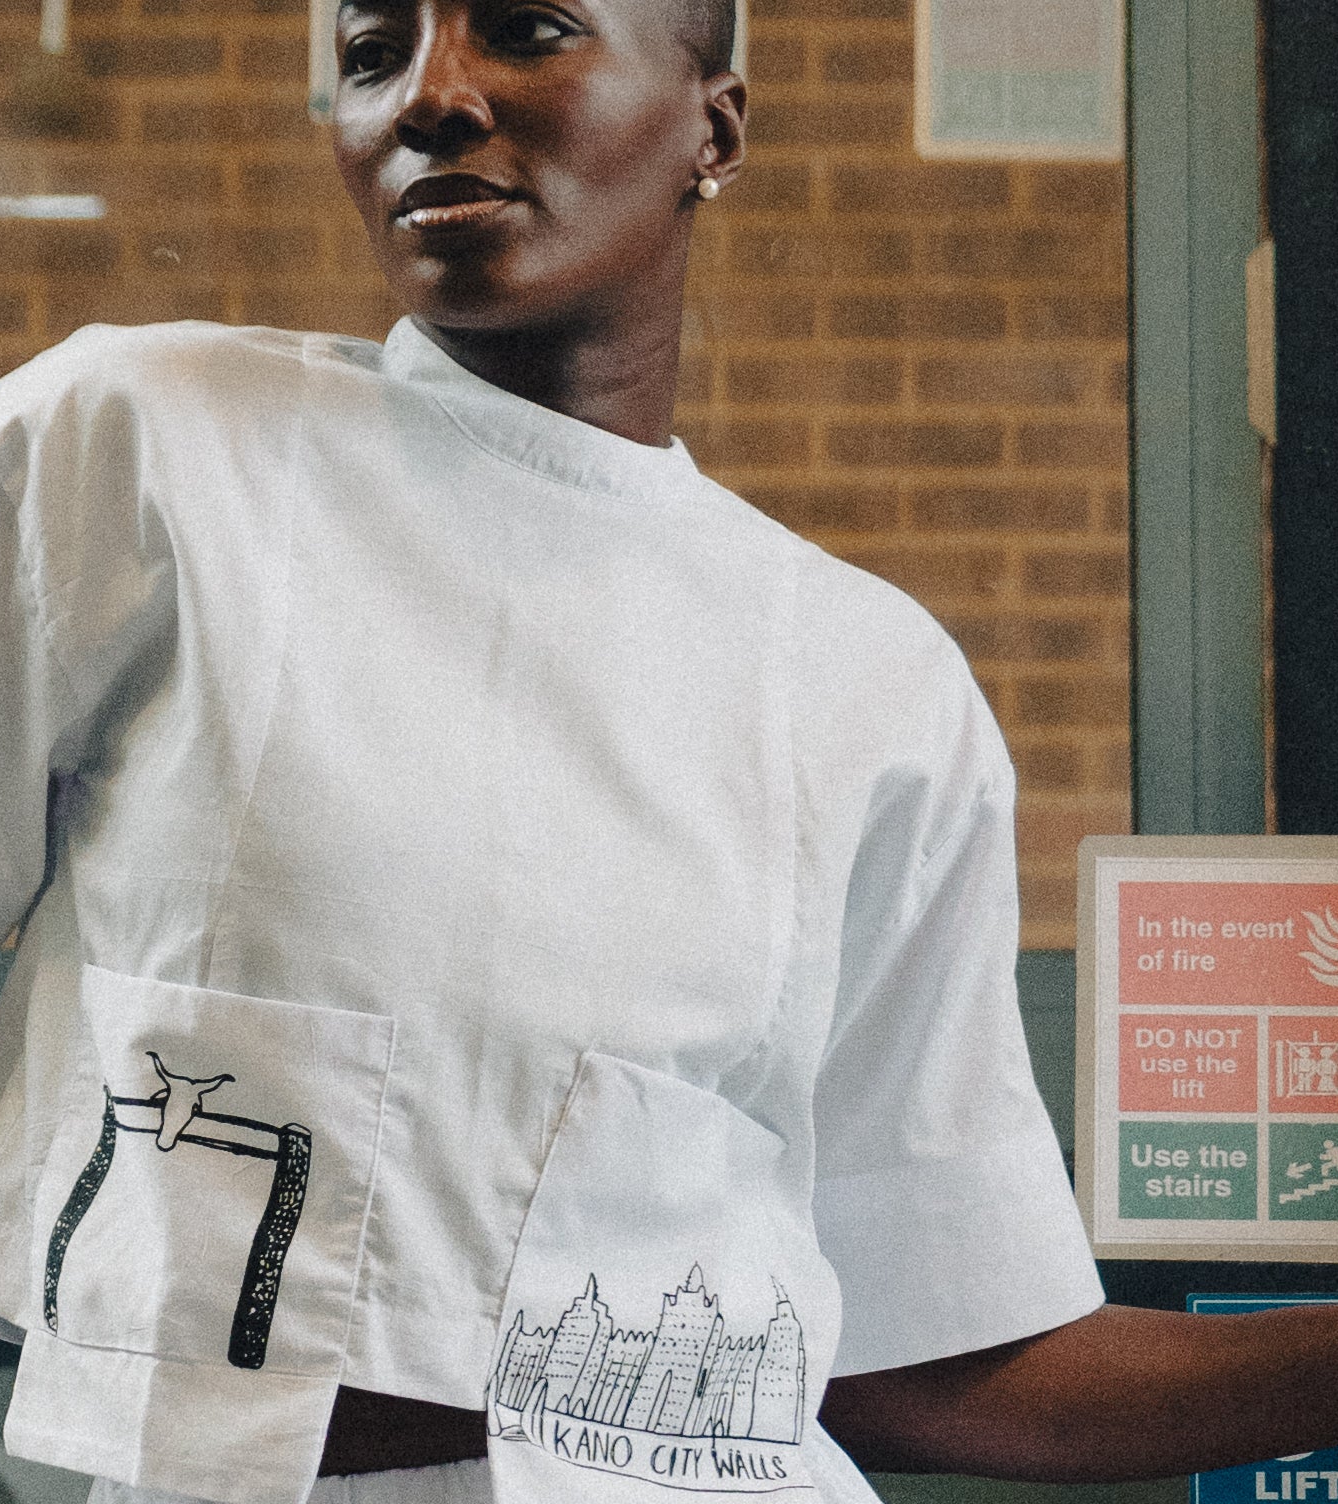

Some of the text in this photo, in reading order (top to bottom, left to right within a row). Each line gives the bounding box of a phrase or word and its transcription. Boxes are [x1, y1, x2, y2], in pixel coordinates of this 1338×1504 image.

[1137, 916, 1296, 939] In the event
[1137, 949, 1216, 972] of fire
[1135, 1027, 1242, 1049] DO NOT
[1141, 1055, 1238, 1074] use the
[1172, 1078, 1205, 1098] lift
[1131, 1143, 1248, 1169] Use the
[1145, 1173, 1232, 1197] stairs
[553, 1419, 788, 1481] KANO CITY WALLS
